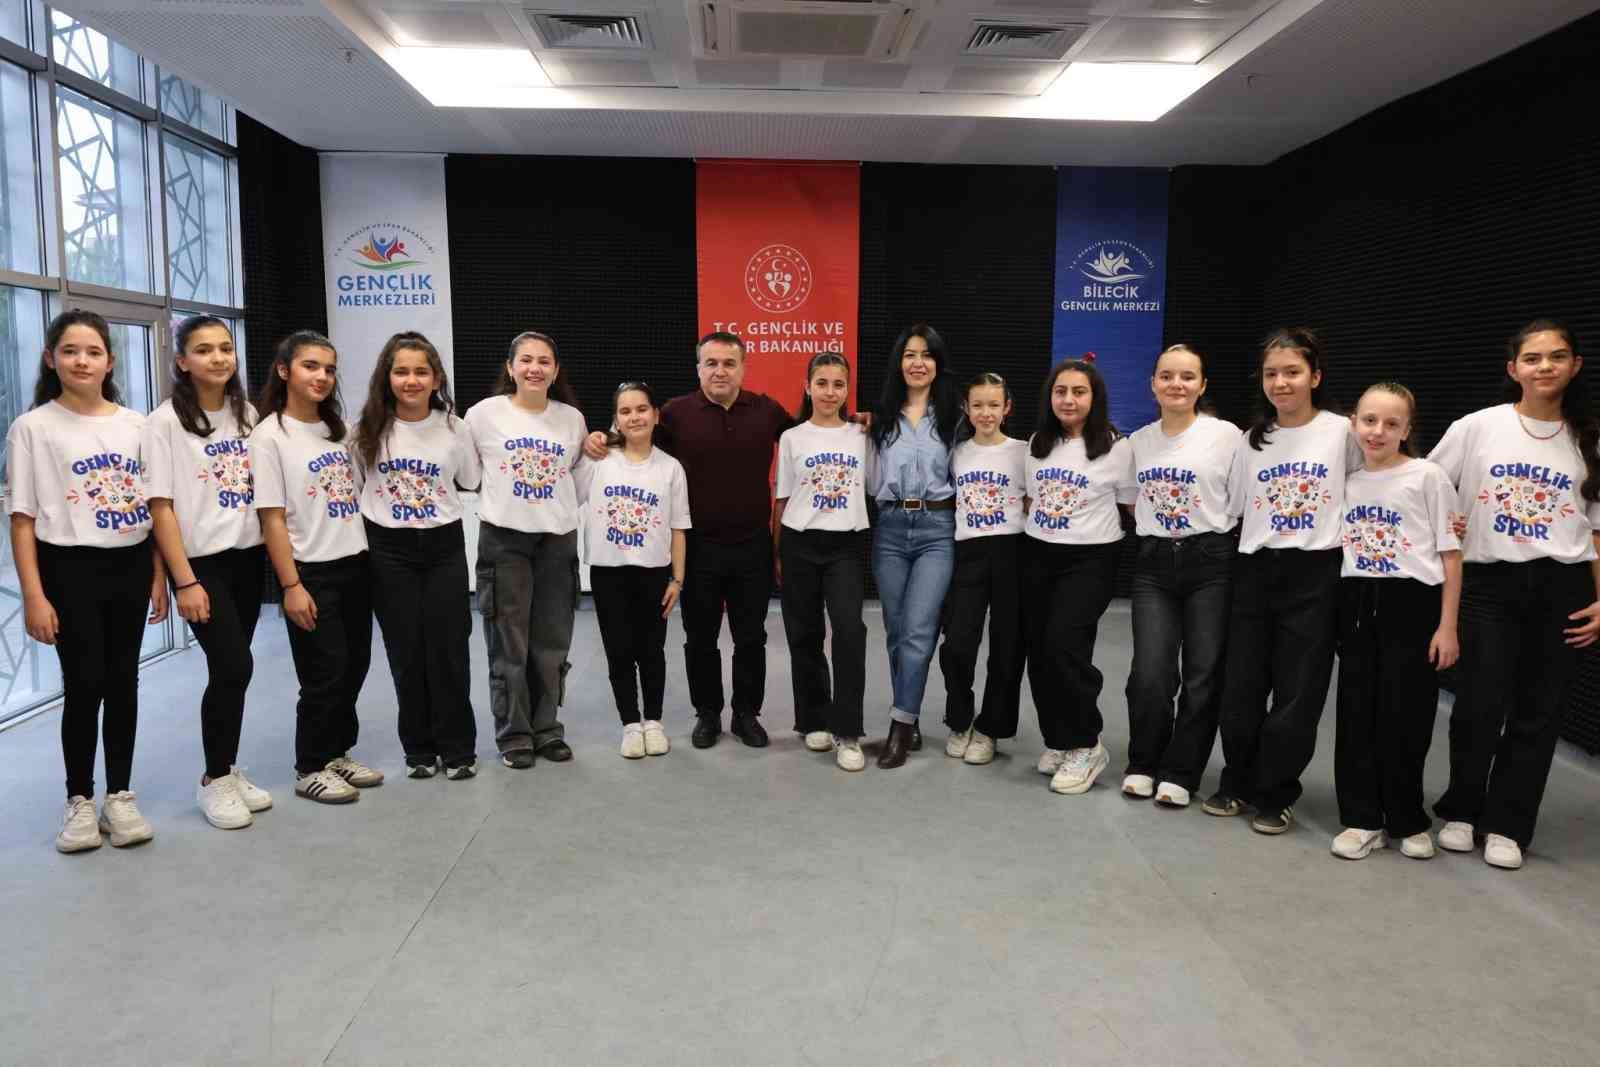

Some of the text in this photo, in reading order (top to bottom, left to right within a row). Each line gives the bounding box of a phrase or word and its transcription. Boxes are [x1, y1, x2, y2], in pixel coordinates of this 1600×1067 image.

[337, 273, 433, 291] GENÇLİK
[1083, 283, 1139, 298] BİLECİK
[338, 293, 435, 306] MERKEZLERİ
[1113, 301, 1160, 311] MERKEZİ
[747, 320, 817, 337] GENÇLİK
[823, 322, 844, 335] VE
[760, 339, 844, 353] BAKANLIĞI
[513, 480, 554, 499] SPOR
[95, 505, 151, 530] SPOR
[392, 504, 437, 521] SPOR
[1493, 513, 1550, 540] SPOR
[606, 526, 644, 547] SPOR
